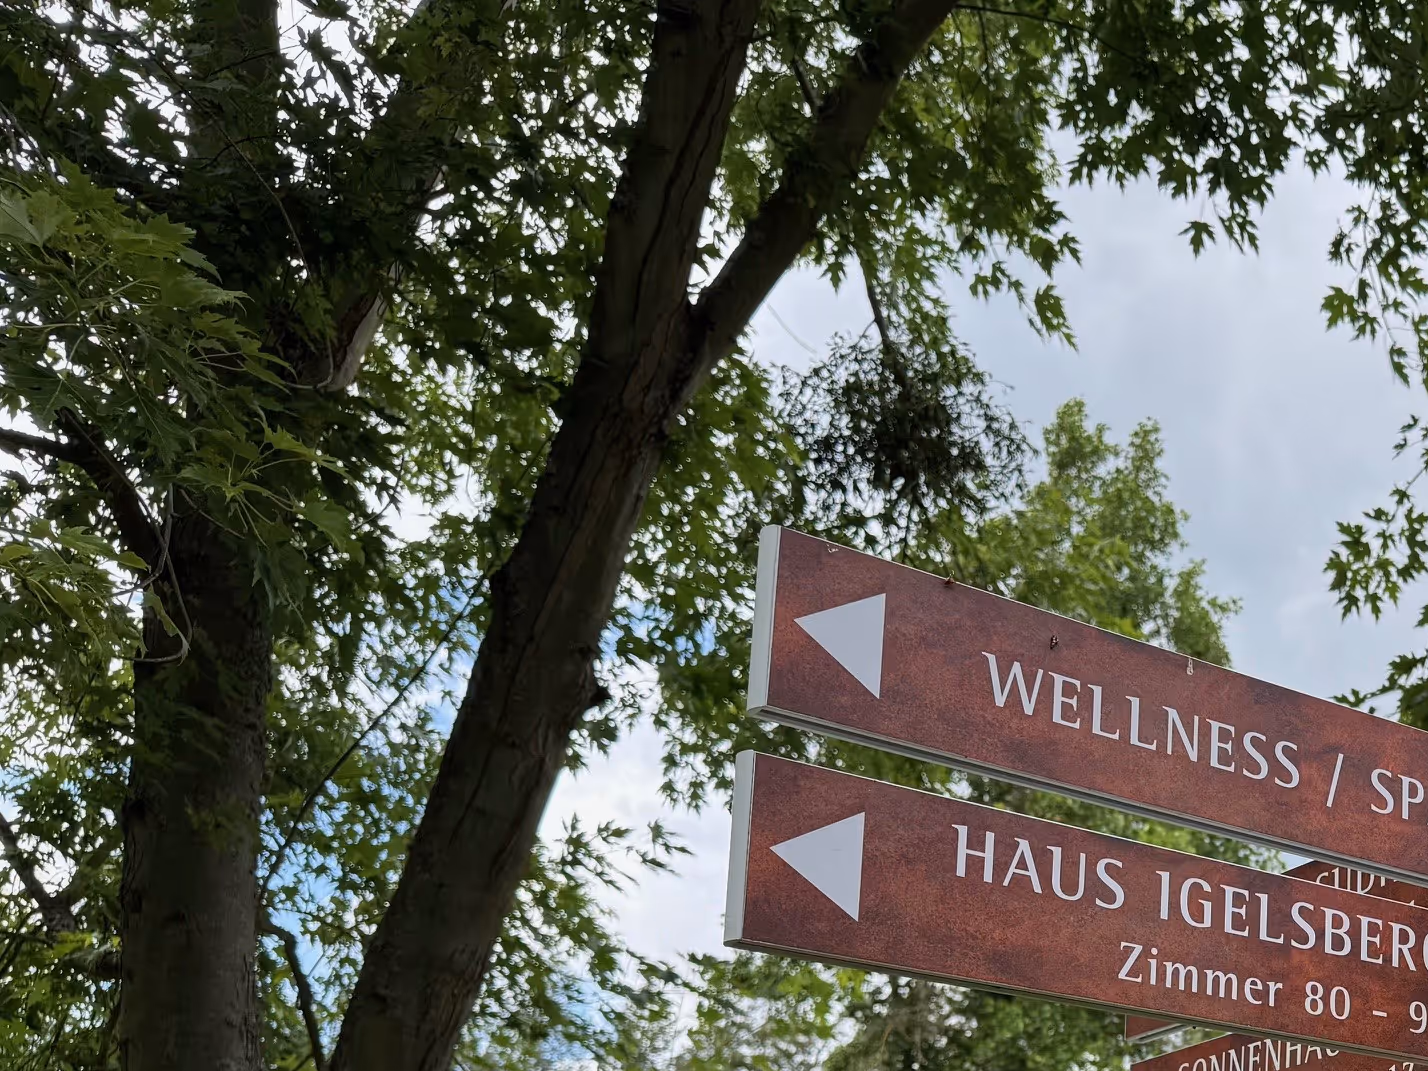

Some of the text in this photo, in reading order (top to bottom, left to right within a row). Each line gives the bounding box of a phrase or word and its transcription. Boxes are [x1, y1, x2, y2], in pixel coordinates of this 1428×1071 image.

[981, 651, 1300, 789] WELLNESS
[1326, 753, 1344, 808] /
[951, 824, 1125, 910] HAUS
[1117, 941, 1283, 1007] Zimmer
[1304, 981, 1351, 1020] 80
[1372, 1010, 1388, 1018] -
